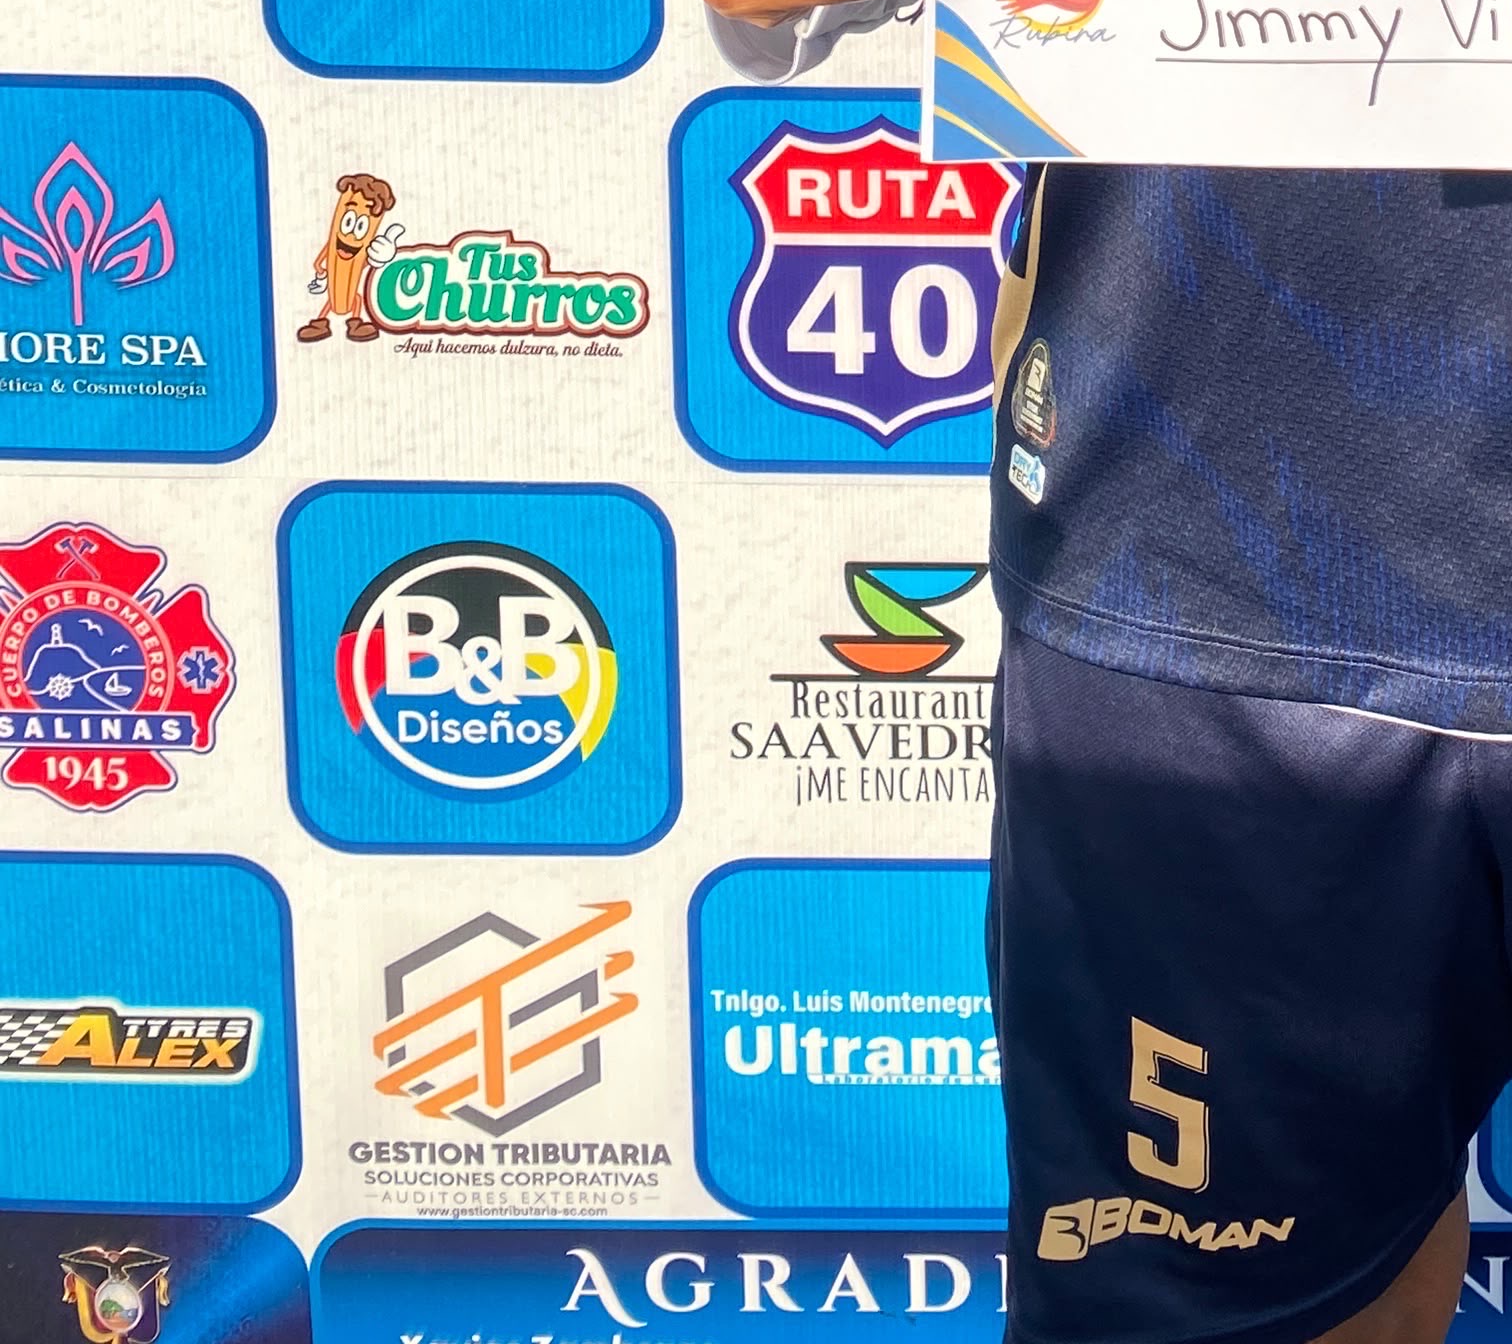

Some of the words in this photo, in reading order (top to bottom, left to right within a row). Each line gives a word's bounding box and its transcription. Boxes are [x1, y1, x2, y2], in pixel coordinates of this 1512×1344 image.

[786, 169, 976, 219] RUTA
[459, 244, 537, 281] Tus
[377, 257, 636, 325] Churros
[786, 264, 978, 378] 40
[122, 335, 207, 366] SPA
[435, 339, 496, 355] hacemos
[562, 345, 580, 356] no
[0, 378, 43, 392] ética
[51, 380, 66, 393] &
[73, 379, 207, 398] Cosmetología
[4, 606, 40, 698] CUERPO
[43, 590, 76, 608] DE
[87, 592, 167, 699] BOMBEROS
[384, 595, 580, 706] B&B
[791, 681, 986, 719] Restaurant
[399, 704, 563, 745] Diseños
[730, 722, 992, 761] SAAVEDR
[42, 756, 129, 791] 1945
[797, 765, 847, 806] ¡ME
[861, 767, 990, 802] ENCANTA
[793, 990, 843, 1012] Luis
[38, 1014, 241, 1068] ALEX
[123, 1019, 249, 1038] TYRES
[725, 1023, 1001, 1076] Ultrama
[1127, 1016, 1208, 1193] 5
[349, 1142, 485, 1164] GESTION
[491, 1144, 672, 1165] TRIBUTARIA
[364, 1171, 495, 1186] SOLUCIONES
[501, 1172, 658, 1186] CORPORATIVAS
[381, 1191, 508, 1205] AUDITORES
[521, 1192, 637, 1205] EXTERNOS
[1090, 1197, 1294, 1251] BOMAN
